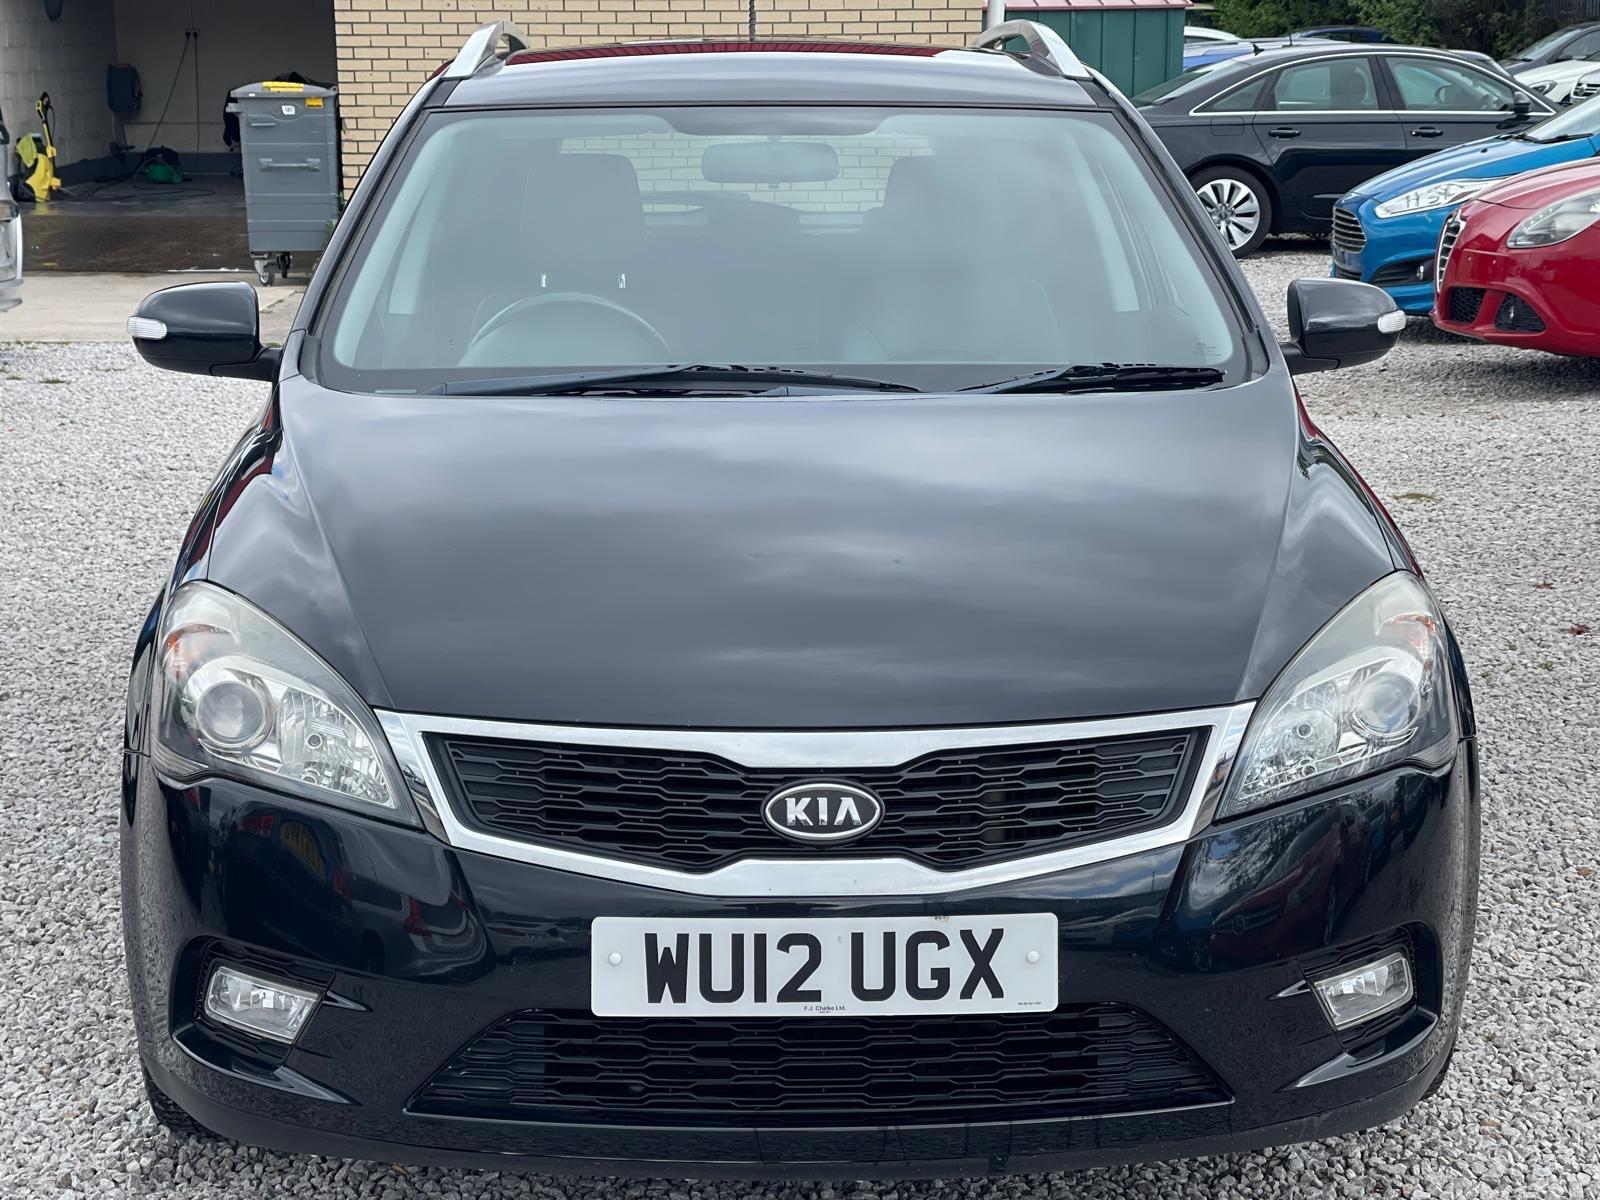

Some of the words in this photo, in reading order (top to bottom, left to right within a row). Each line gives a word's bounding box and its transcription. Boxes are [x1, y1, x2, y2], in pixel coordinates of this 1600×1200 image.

[785, 797, 863, 826] KIA
[644, 932, 822, 1004] WU12
[850, 928, 1005, 1001] UGX
